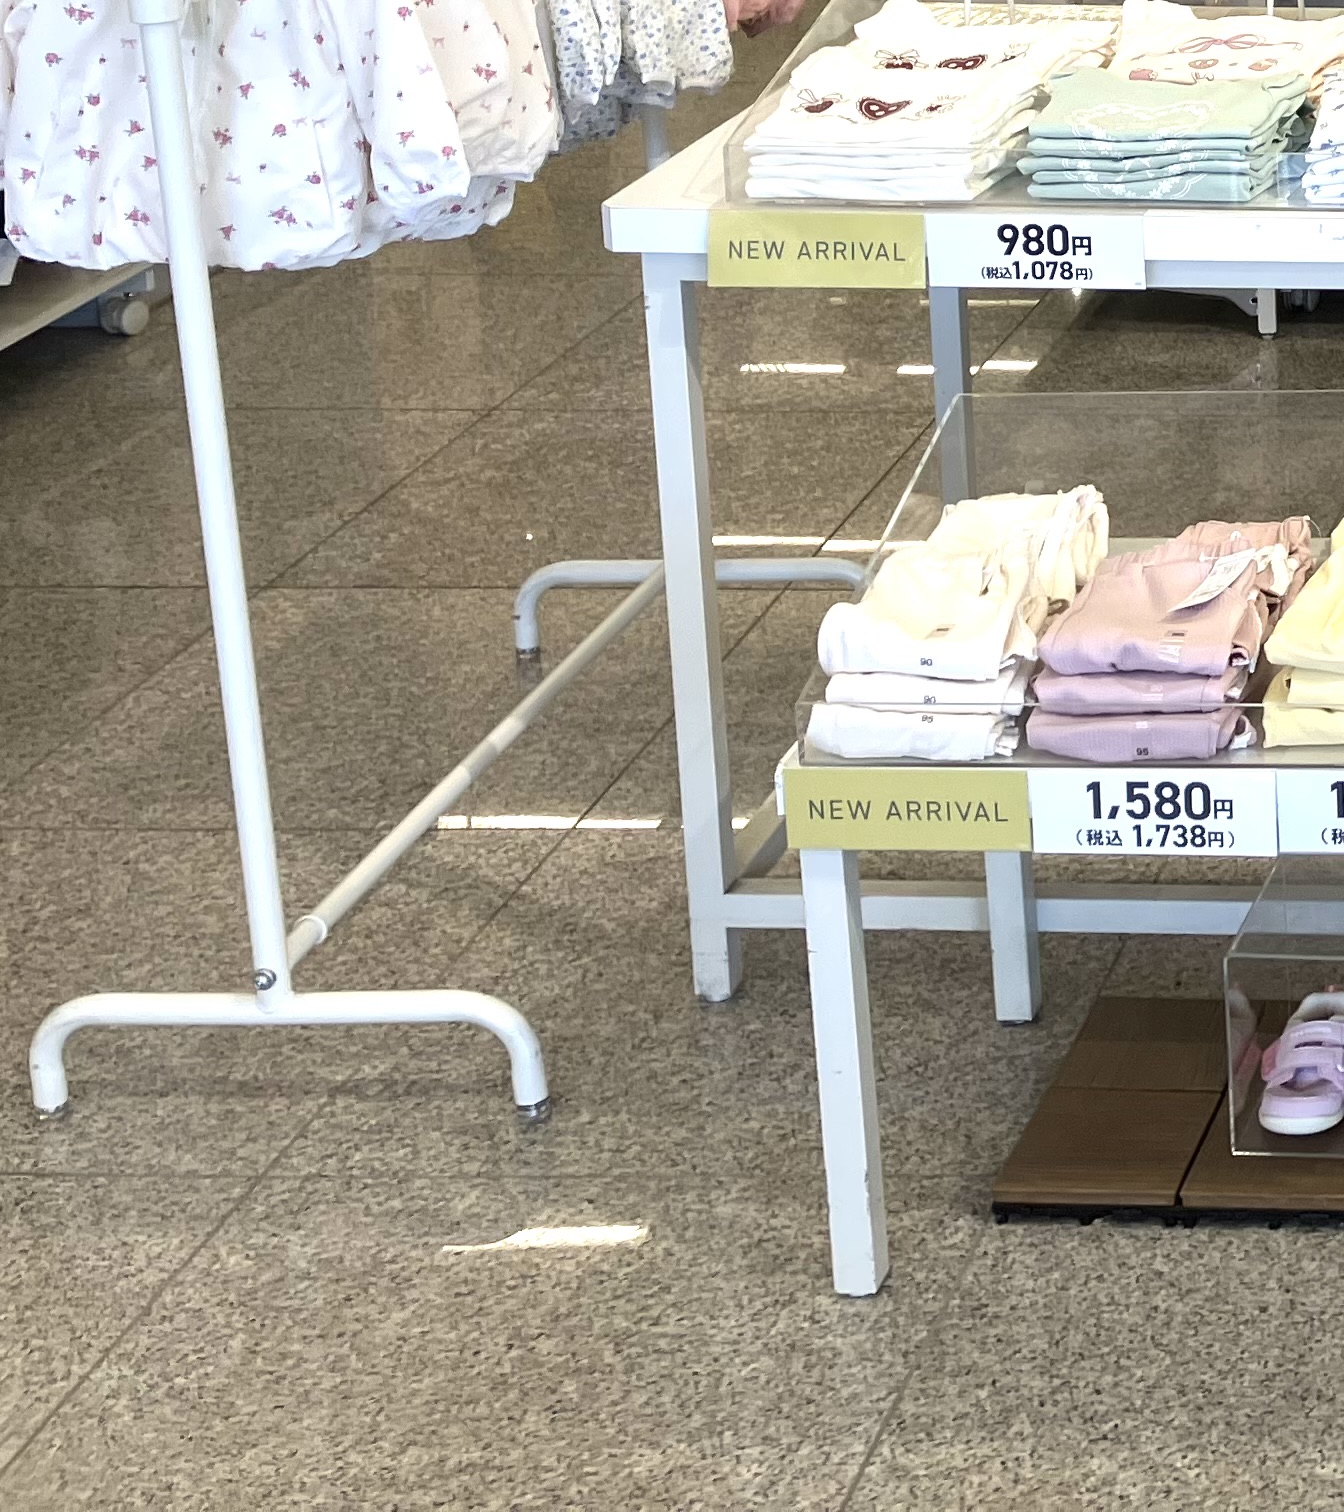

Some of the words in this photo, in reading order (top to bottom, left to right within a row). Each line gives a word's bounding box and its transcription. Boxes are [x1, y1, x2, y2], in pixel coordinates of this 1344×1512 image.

[728, 240, 785, 260] NEW
[798, 241, 906, 262] ARRIVAL
[997, 223, 1092, 257] 980円
[981, 261, 1093, 281] (税込1,078円)
[808, 799, 873, 821] NEW
[886, 799, 1009, 823] ARRIVAL
[1086, 780, 1234, 823] 1,580円
